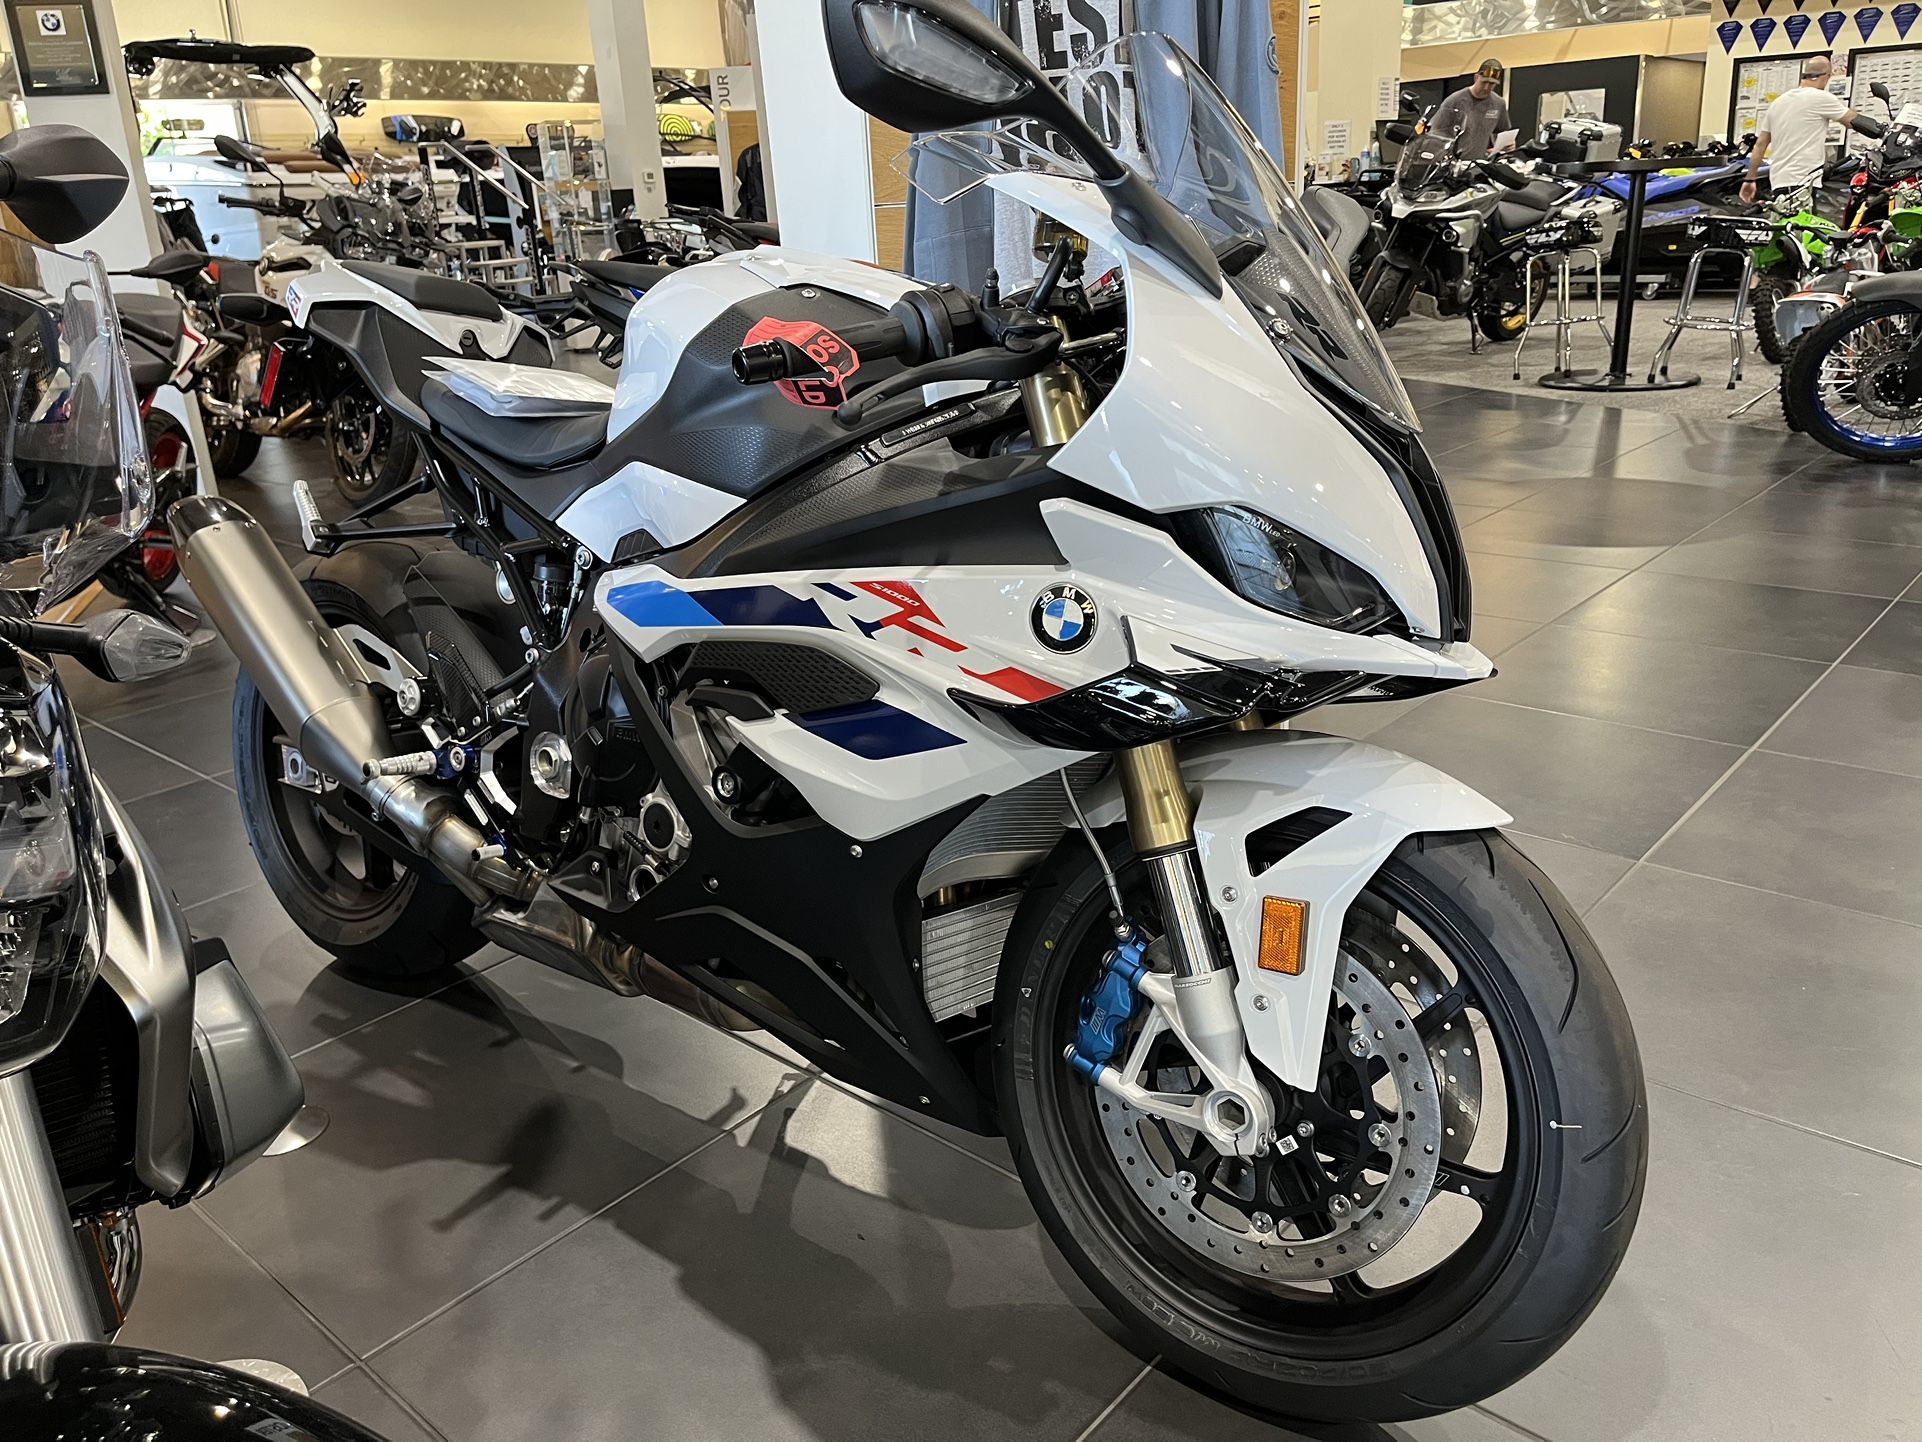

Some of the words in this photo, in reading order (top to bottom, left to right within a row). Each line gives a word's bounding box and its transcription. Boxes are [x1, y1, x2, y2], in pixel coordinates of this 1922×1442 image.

[1242, 513, 1273, 533] BMW
[869, 582, 921, 607] S1000
[1043, 586, 1094, 614] BMW
